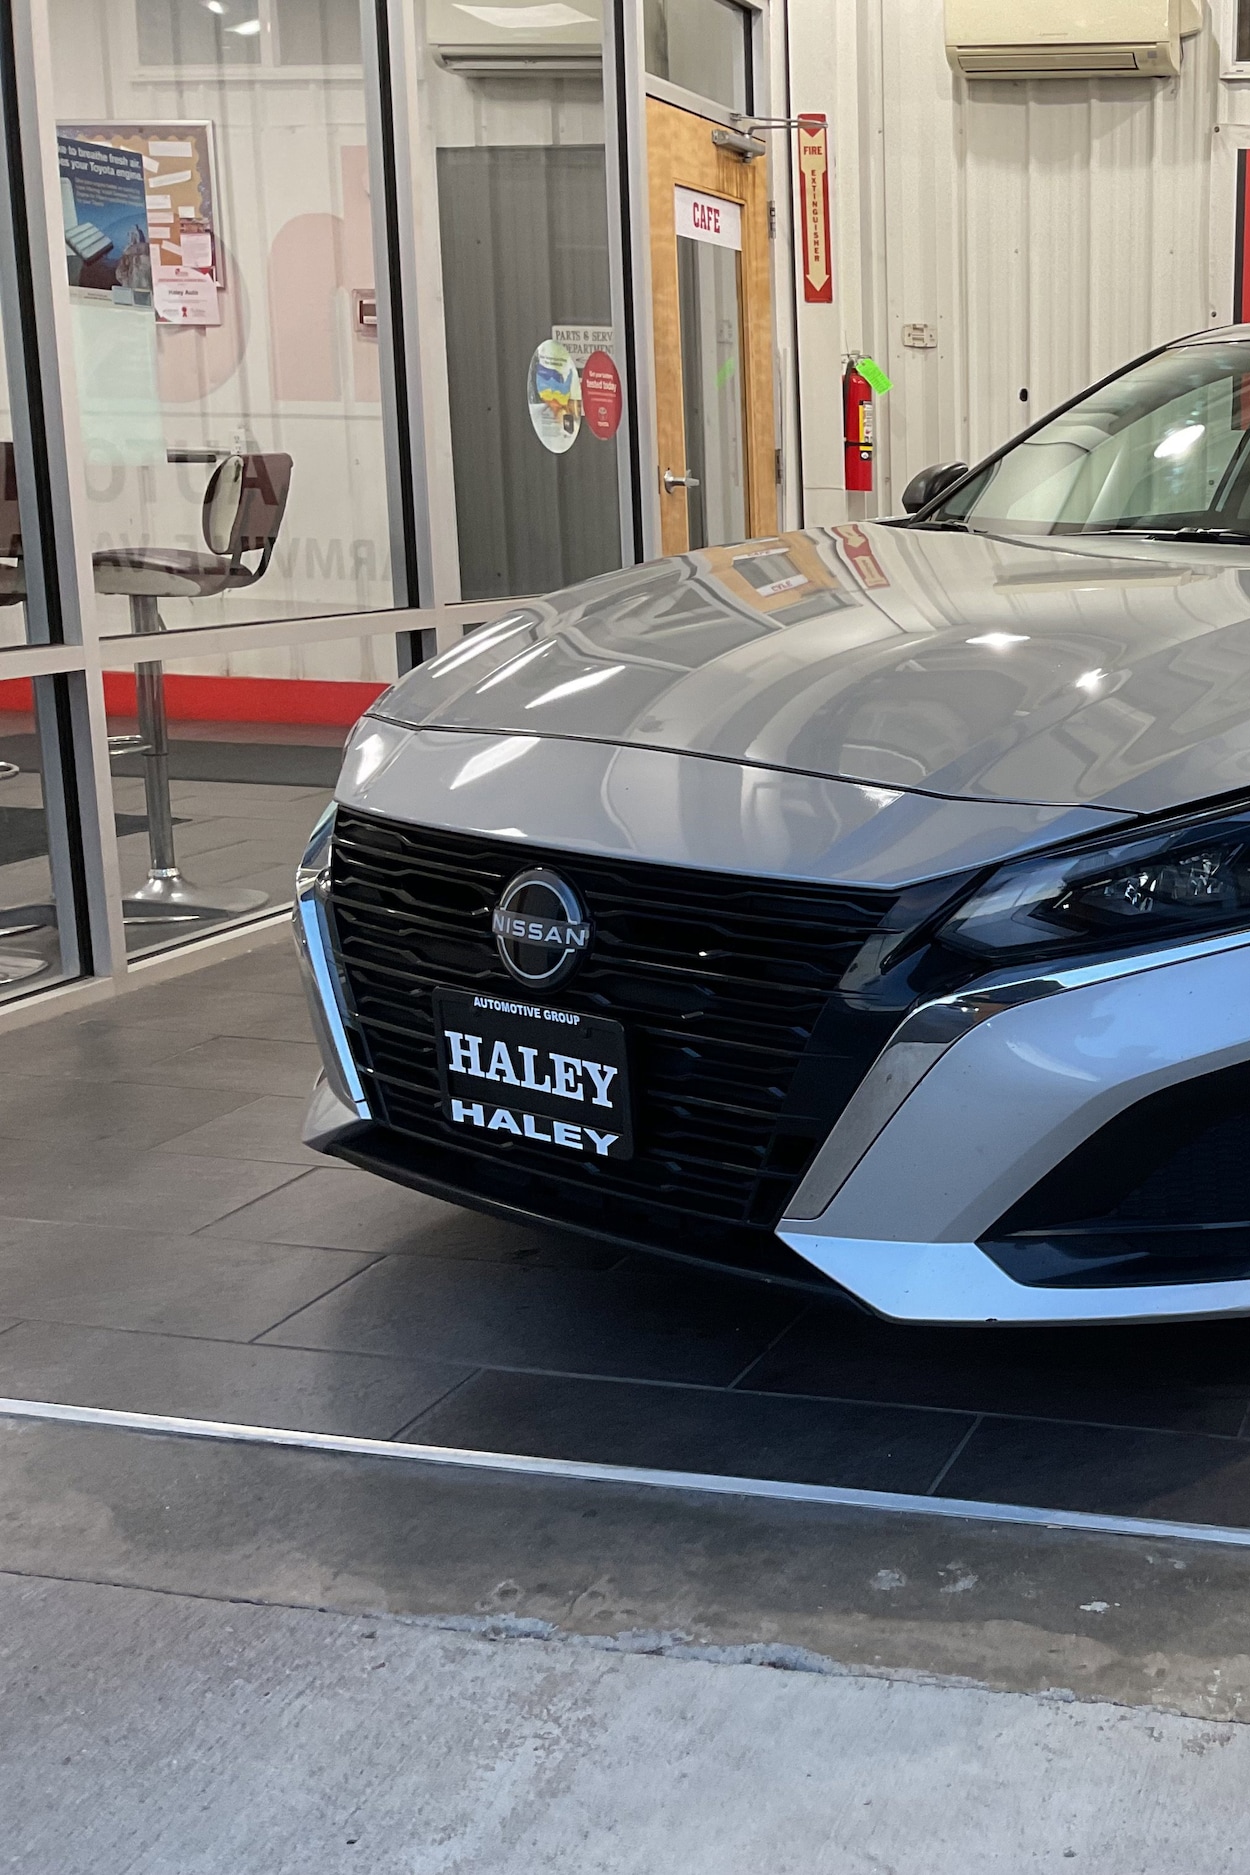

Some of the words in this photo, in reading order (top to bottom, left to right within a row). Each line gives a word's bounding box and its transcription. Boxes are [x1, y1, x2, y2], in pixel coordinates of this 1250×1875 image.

[803, 146, 823, 155] FIRE
[70, 160, 88, 170] your
[89, 162, 115, 175] Toyota
[693, 202, 721, 233] CAFE
[811, 169, 820, 262] EXTINGUISHER
[555, 330, 580, 341] PARTS
[493, 912, 586, 947] NISSAN
[474, 996, 542, 1019] AUTOMOTIVE
[543, 1009, 580, 1026] GROUP
[444, 1030, 618, 1109] HALEY
[451, 1099, 619, 1157] HALEY
